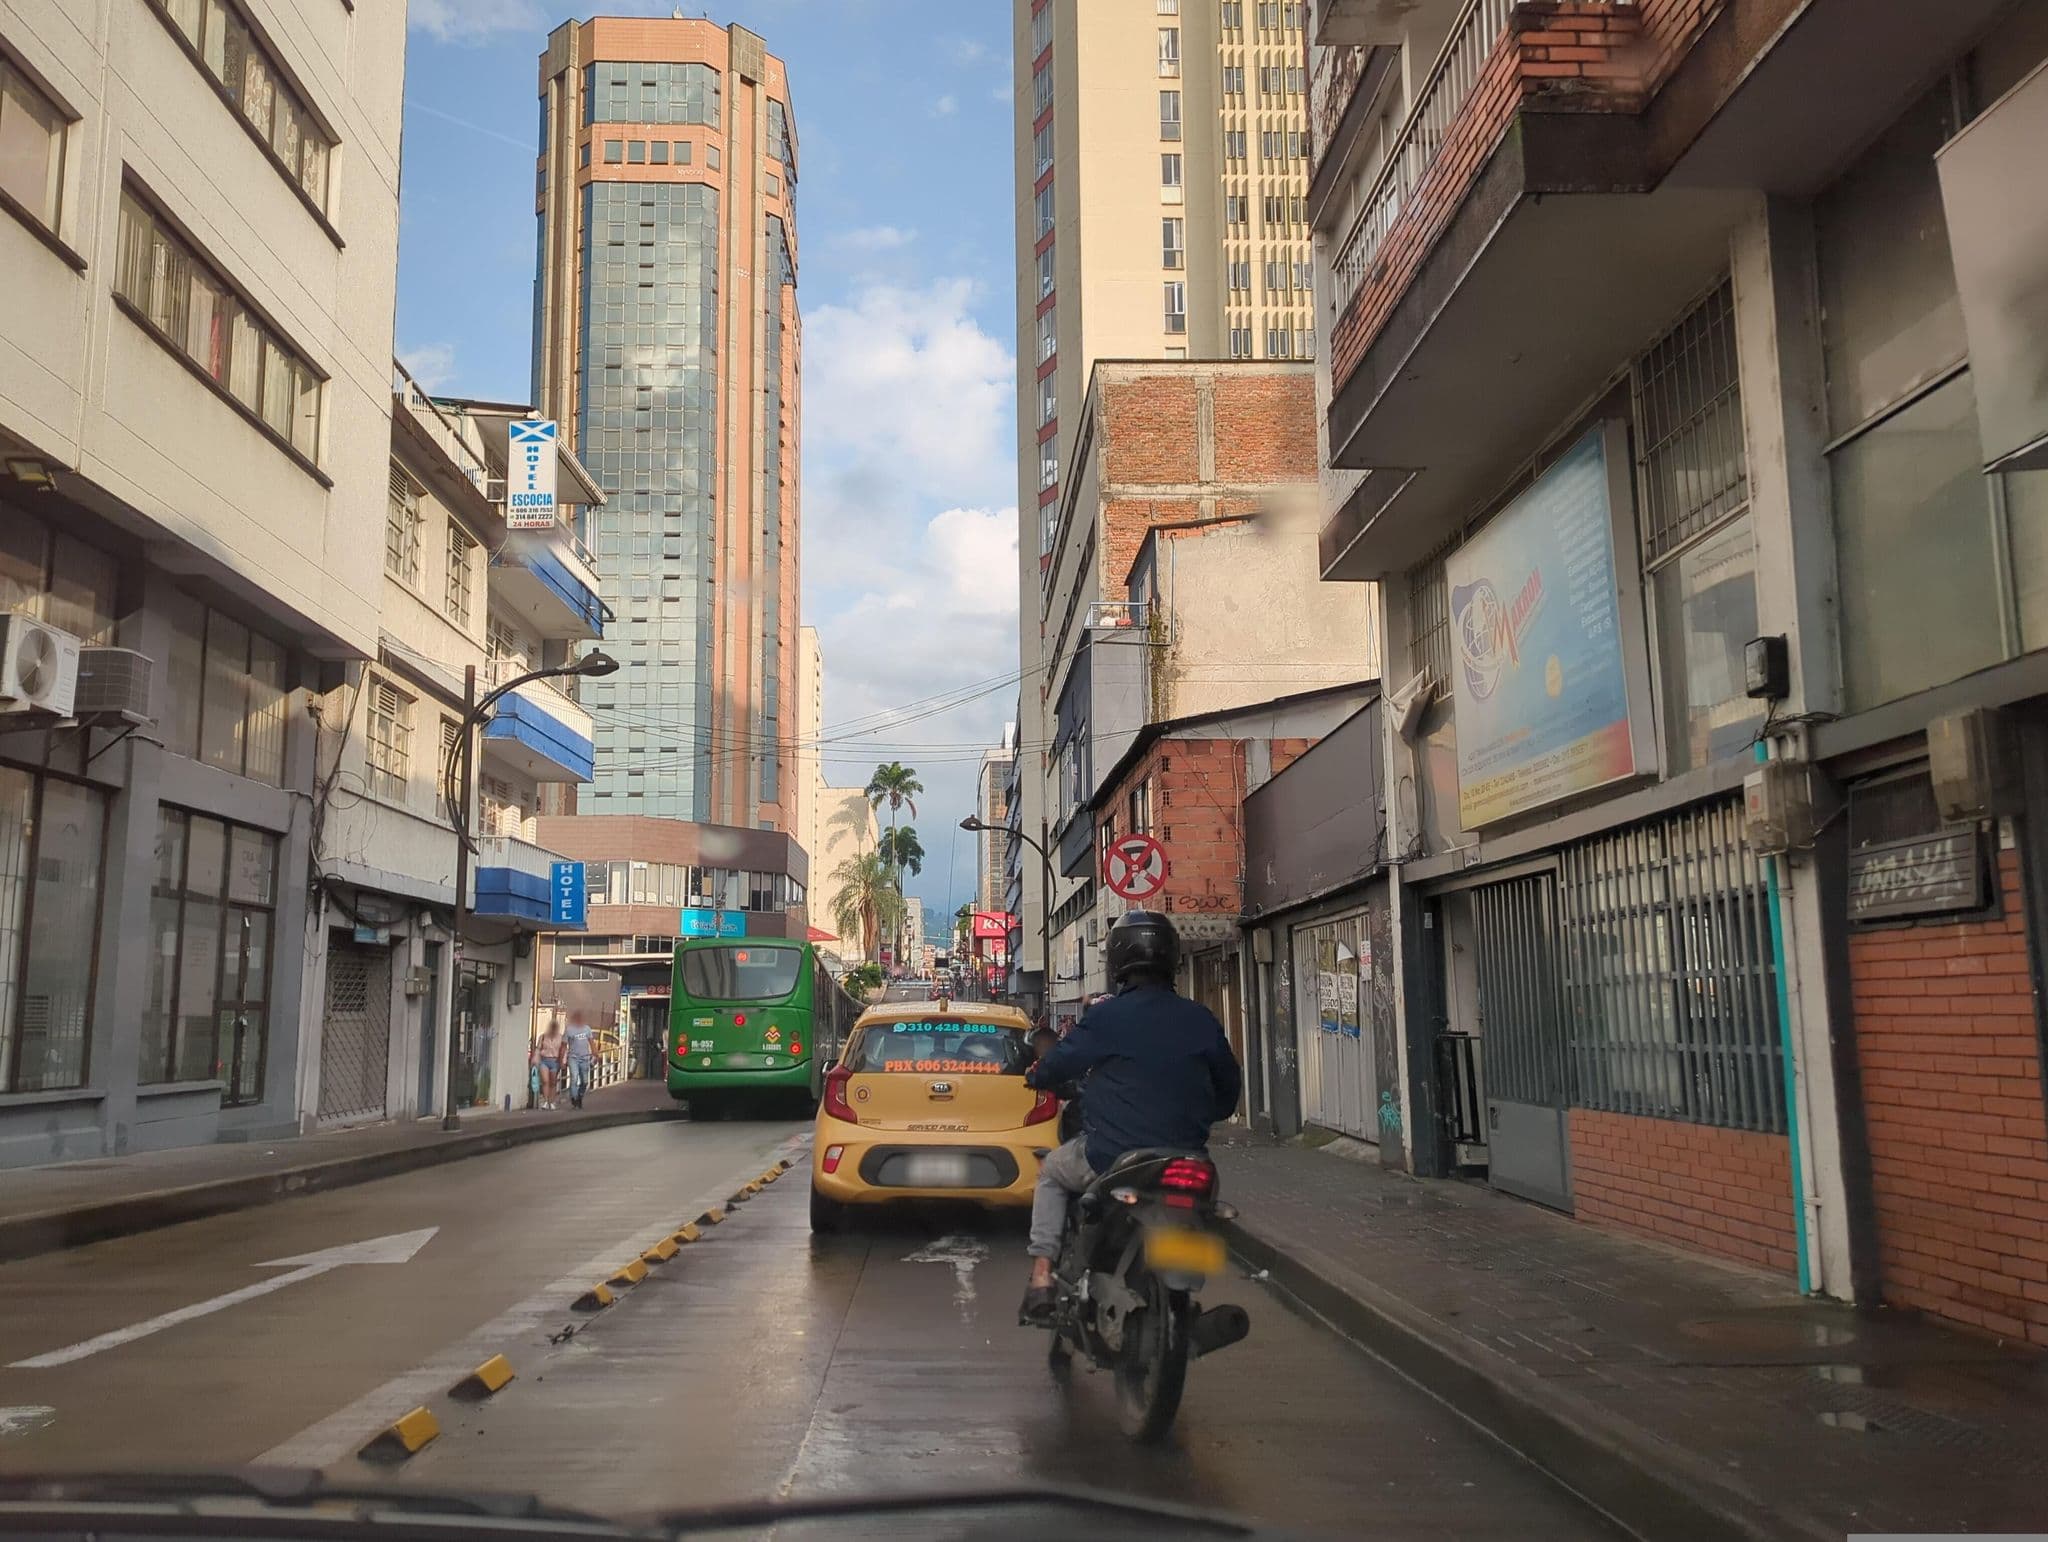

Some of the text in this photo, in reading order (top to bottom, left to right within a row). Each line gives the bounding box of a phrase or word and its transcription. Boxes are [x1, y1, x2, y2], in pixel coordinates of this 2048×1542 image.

[526, 445, 539, 490] HOTEL
[512, 494, 552, 506] ESCOCIA
[560, 864, 573, 920] HOTEL
[907, 1023, 997, 1034] 310 428 8888
[884, 1061, 914, 1072] PBX
[915, 1060, 941, 1072] 606
